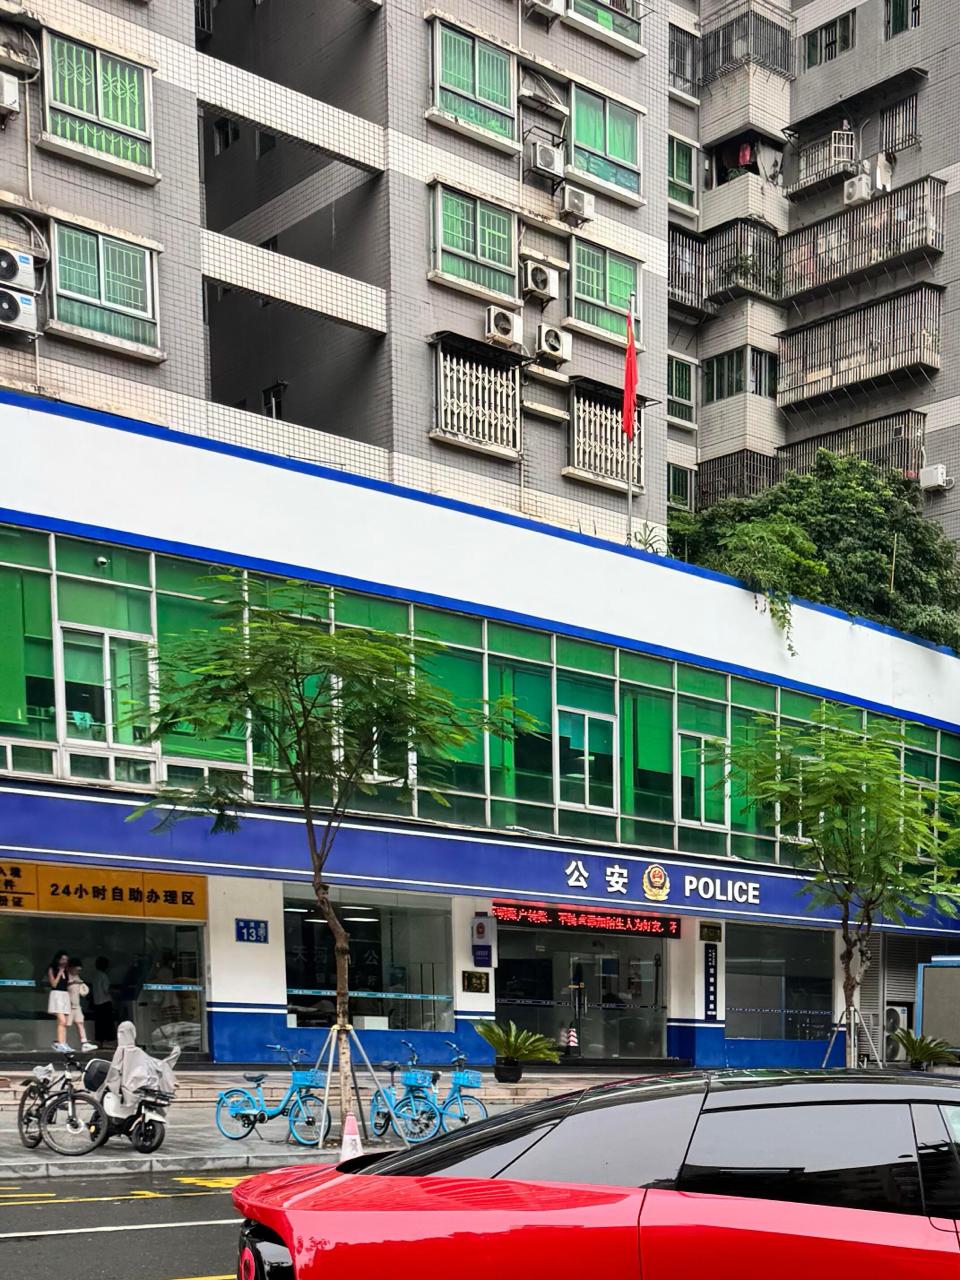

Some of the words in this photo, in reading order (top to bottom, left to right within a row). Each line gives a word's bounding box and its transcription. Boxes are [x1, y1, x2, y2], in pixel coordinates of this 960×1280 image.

[565, 860, 628, 895] 公安
[684, 875, 761, 904] POLICE
[50, 883, 195, 906] 24小时自助办理区
